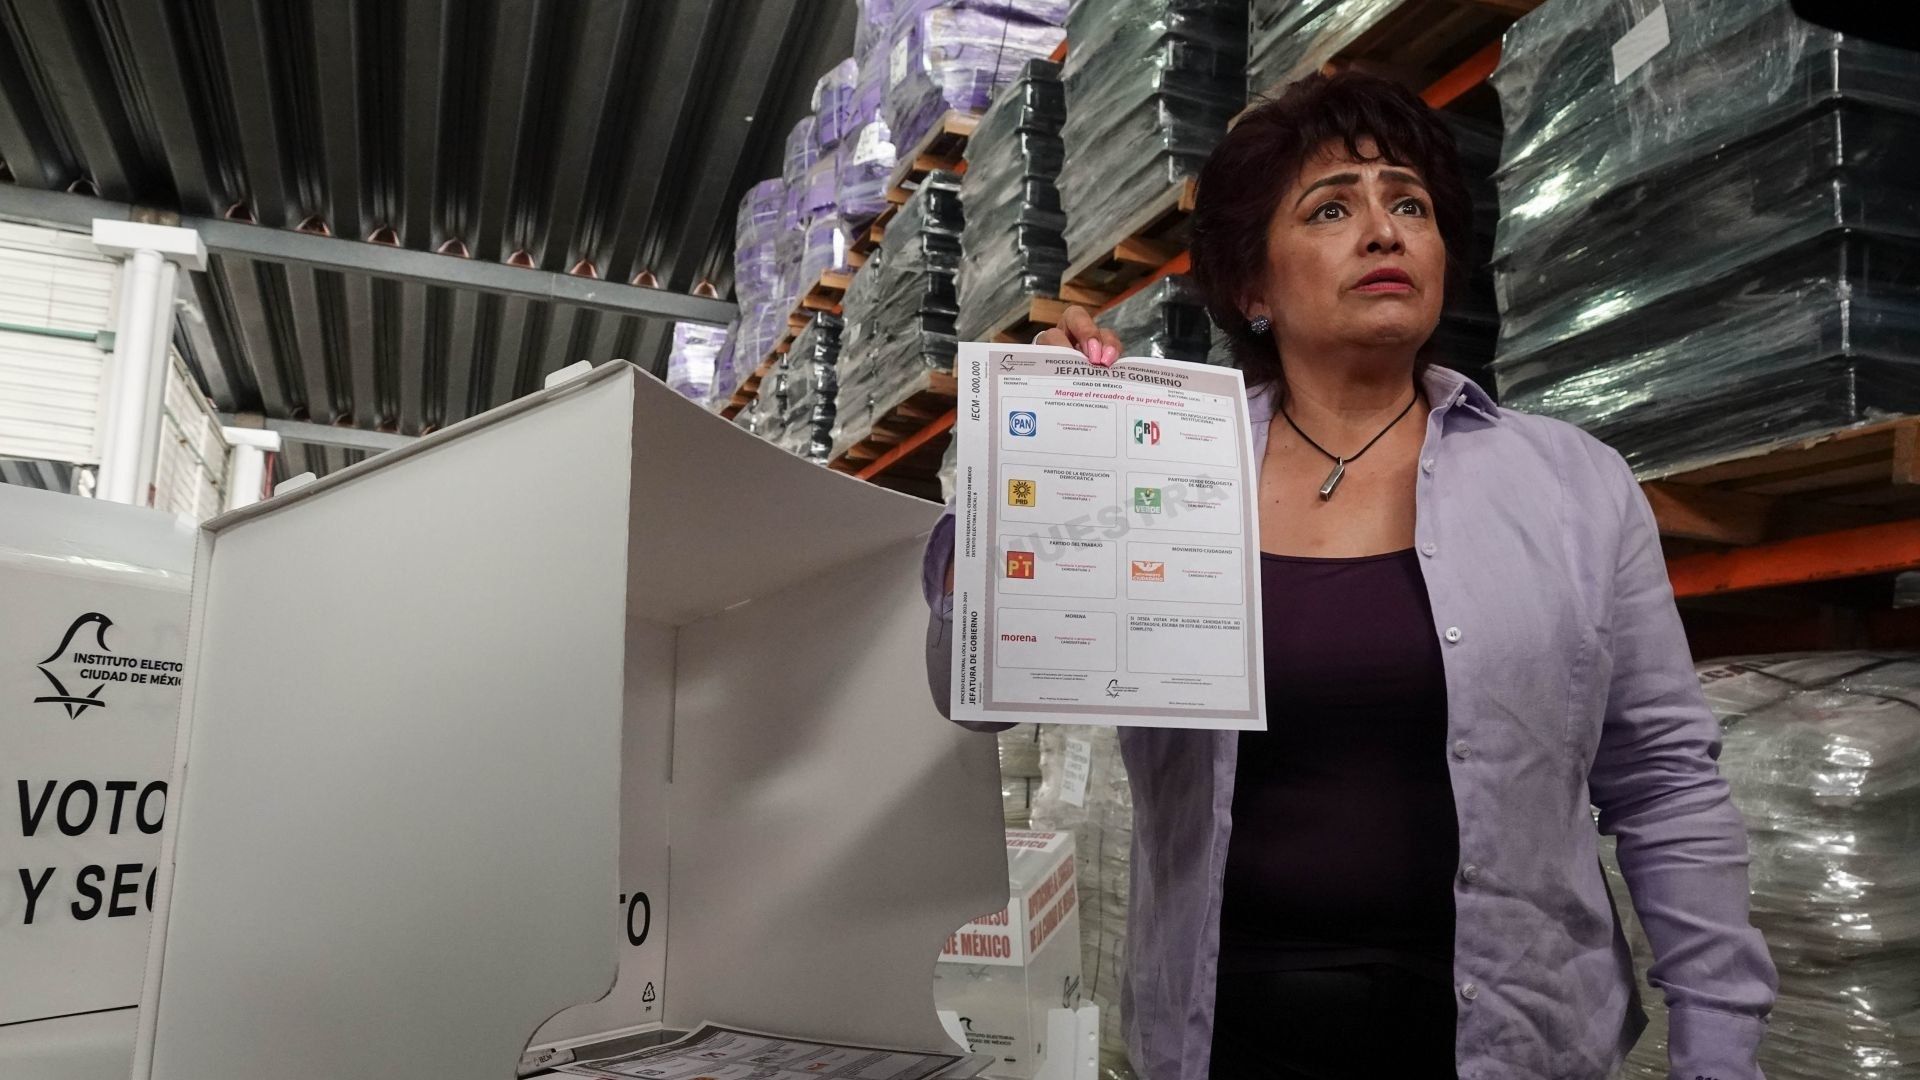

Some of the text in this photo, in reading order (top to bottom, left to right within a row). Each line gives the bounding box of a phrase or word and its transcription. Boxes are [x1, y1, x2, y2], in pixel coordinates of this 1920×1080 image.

[1054, 366, 1182, 388] JEFATURA DE GOBIERNO
[1055, 389, 1083, 398] Marque
[1085, 390, 1092, 398] el
[1092, 391, 1125, 401] recuadro
[1145, 396, 1185, 408] preferencia
[971, 399, 980, 421] IECM
[1014, 418, 1031, 429] PAN
[1135, 422, 1158, 440] PRI
[1135, 505, 1161, 514] VERDE
[991, 473, 1231, 580] MUESTRA
[1008, 559, 1033, 577] PT
[1001, 633, 1037, 643] morena
[73, 652, 138, 668] INSTITUTO
[969, 611, 978, 705] JEFATURA DE GOBIERNO
[80, 668, 181, 686] CIUDAD DE MÉXI
[17, 780, 168, 837] VOTO
[18, 863, 157, 925] Y SE
[943, 929, 1011, 958] DE MÉXICO
